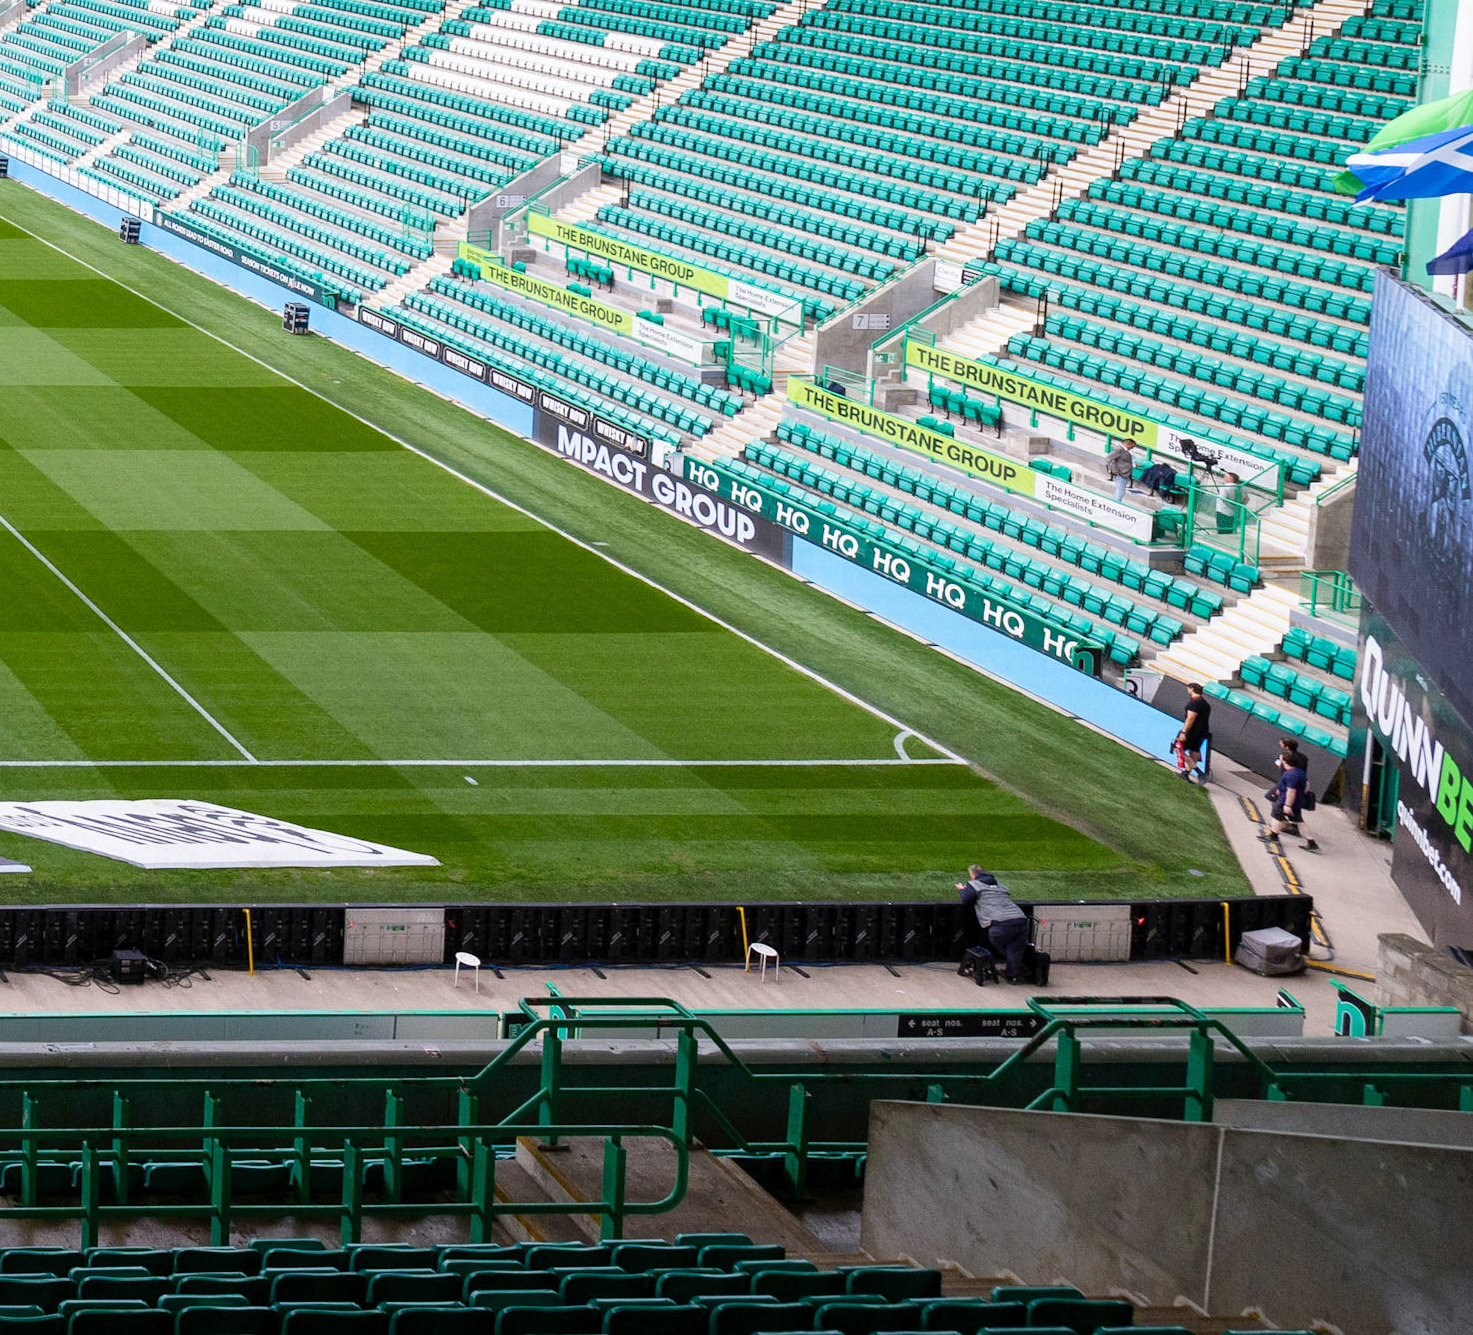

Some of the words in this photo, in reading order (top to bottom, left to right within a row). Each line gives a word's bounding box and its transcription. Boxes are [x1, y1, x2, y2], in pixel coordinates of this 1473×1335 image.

[172, 223, 186, 238] ROADS
[186, 229, 197, 243] LEAD
[204, 237, 220, 253] EASTER
[556, 224, 578, 243] THE
[579, 231, 648, 269] BRUNSTANE
[650, 256, 694, 281] GROUP
[241, 255, 259, 270] SEASON
[260, 263, 279, 279] TICKETS
[301, 281, 314, 296] NOW
[488, 266, 509, 283] THE
[510, 273, 577, 312] BRUNSTANE
[579, 300, 623, 326] GROUP
[650, 325, 666, 338] Home
[666, 333, 694, 350] Extension
[492, 370, 517, 392] WHISKY
[919, 348, 950, 372] THE
[953, 359, 1067, 415] BRUNSTANE
[1070, 397, 1145, 436] GROUP
[541, 393, 569, 417] WHISKY
[597, 419, 625, 443] WHISKY
[804, 387, 835, 412] THE
[837, 402, 944, 454] BRUNSTANE
[947, 443, 1016, 481] GROUP
[1217, 450, 1265, 472] Extension
[557, 425, 647, 491] MPACT
[652, 473, 756, 544] GROUP
[776, 502, 810, 535] HQ
[1045, 490, 1093, 515] Specialists
[1046, 481, 1063, 492] The
[1064, 487, 1090, 502] Home
[1091, 498, 1137, 523] Extension
[823, 524, 859, 559] HQ
[873, 547, 911, 583] HQ
[927, 573, 966, 610] HQ
[983, 600, 1024, 639] HQ
[1397, 799, 1462, 905] quinnbet.com
[921, 1019, 940, 1027] seat
[945, 1019, 963, 1027] nos.
[926, 1028, 943, 1036] A-S
[982, 1019, 1001, 1027] seat
[1006, 1019, 1024, 1027] nos.
[1000, 1028, 1017, 1036] A-S
